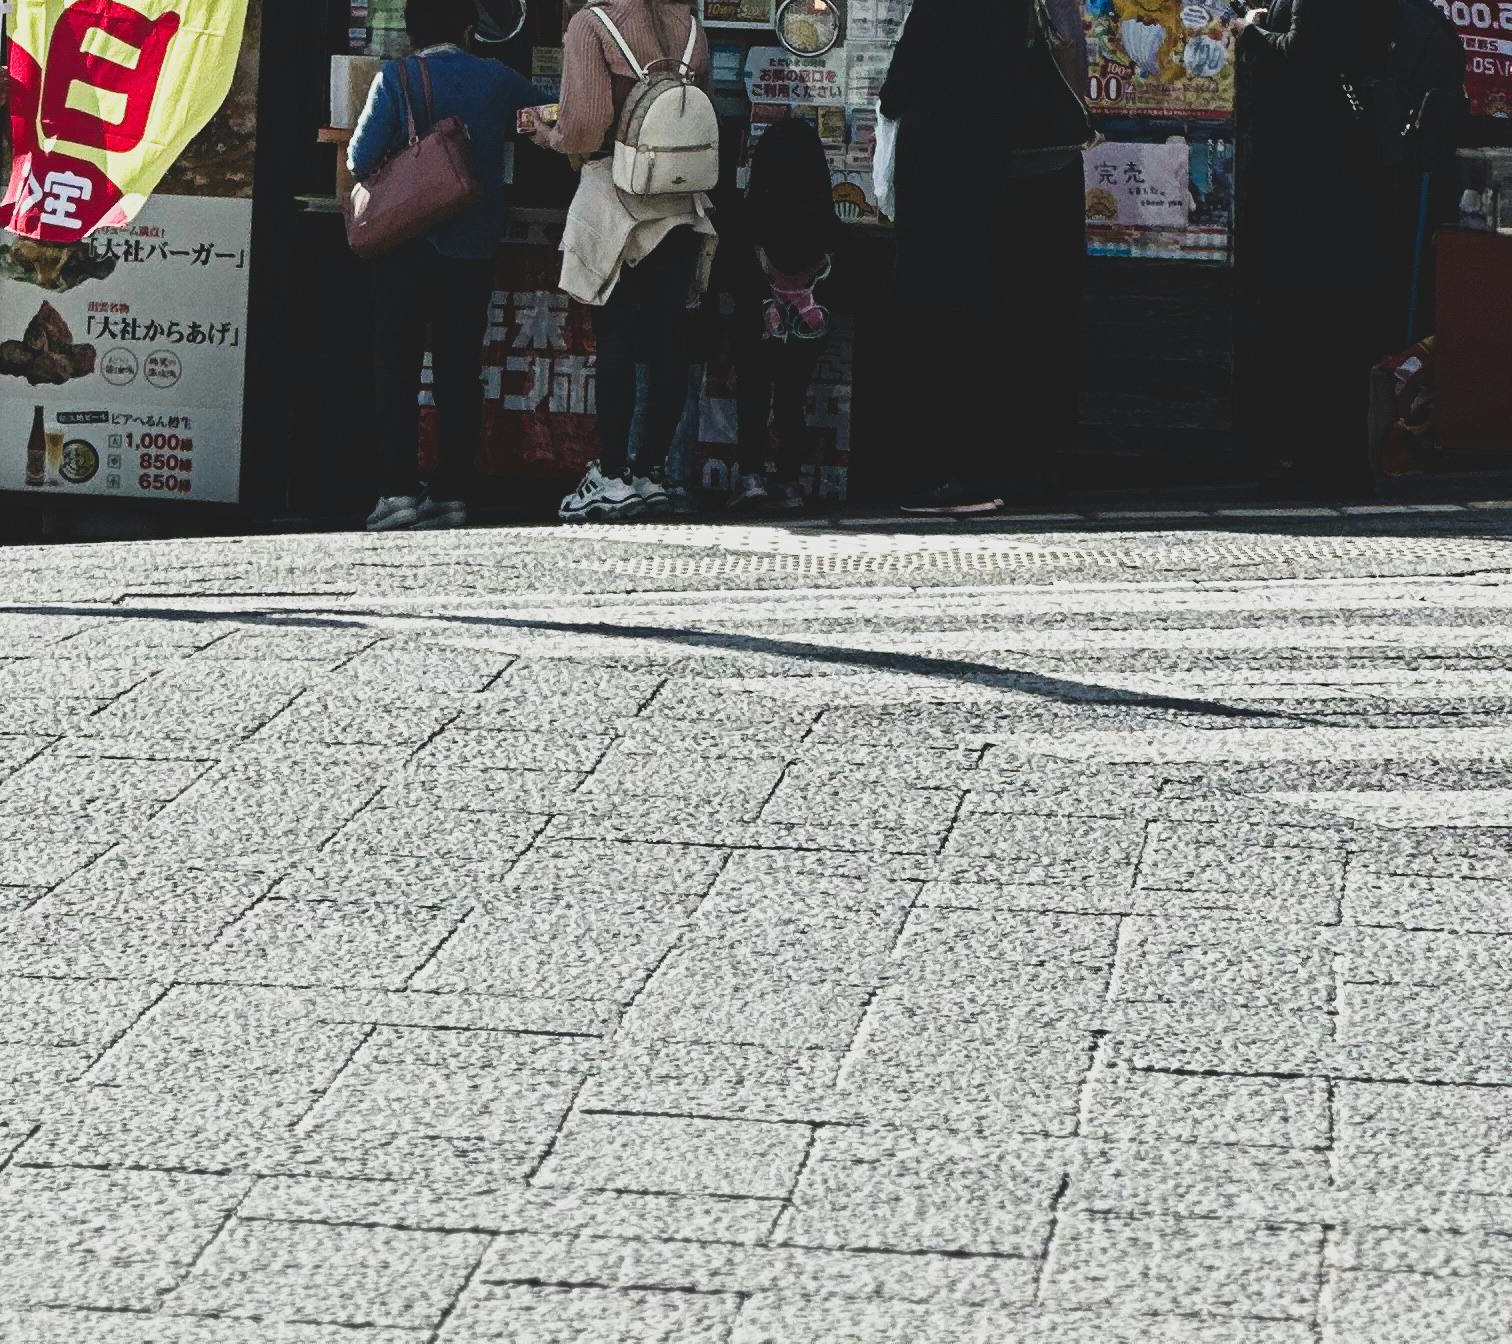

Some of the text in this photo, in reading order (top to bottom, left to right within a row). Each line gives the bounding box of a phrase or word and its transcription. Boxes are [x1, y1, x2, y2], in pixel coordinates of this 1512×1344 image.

[751, 83, 842, 98] ご利用ください
[1094, 161, 1145, 185] 完売
[87, 315, 239, 347] 「大社からあげ」
